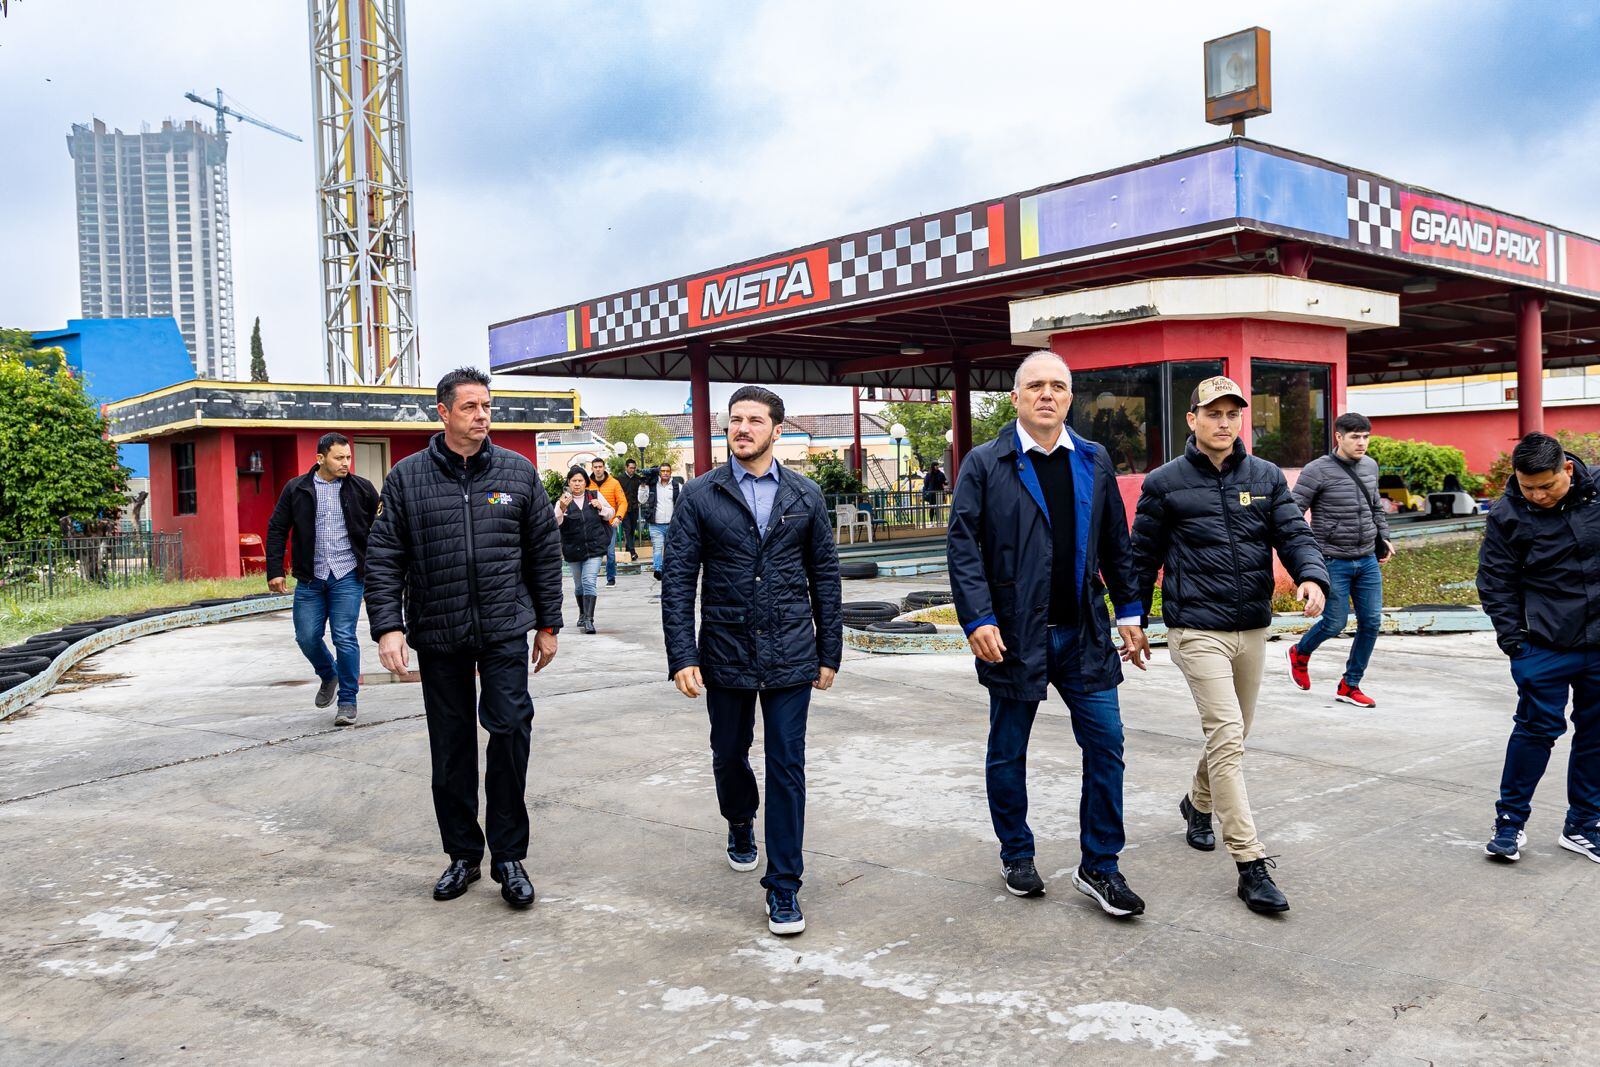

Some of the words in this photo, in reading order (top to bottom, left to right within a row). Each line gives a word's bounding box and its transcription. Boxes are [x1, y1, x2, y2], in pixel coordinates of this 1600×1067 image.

[1410, 208, 1493, 254] GRAND
[1495, 228, 1541, 266] PRIX
[701, 260, 813, 318] META
